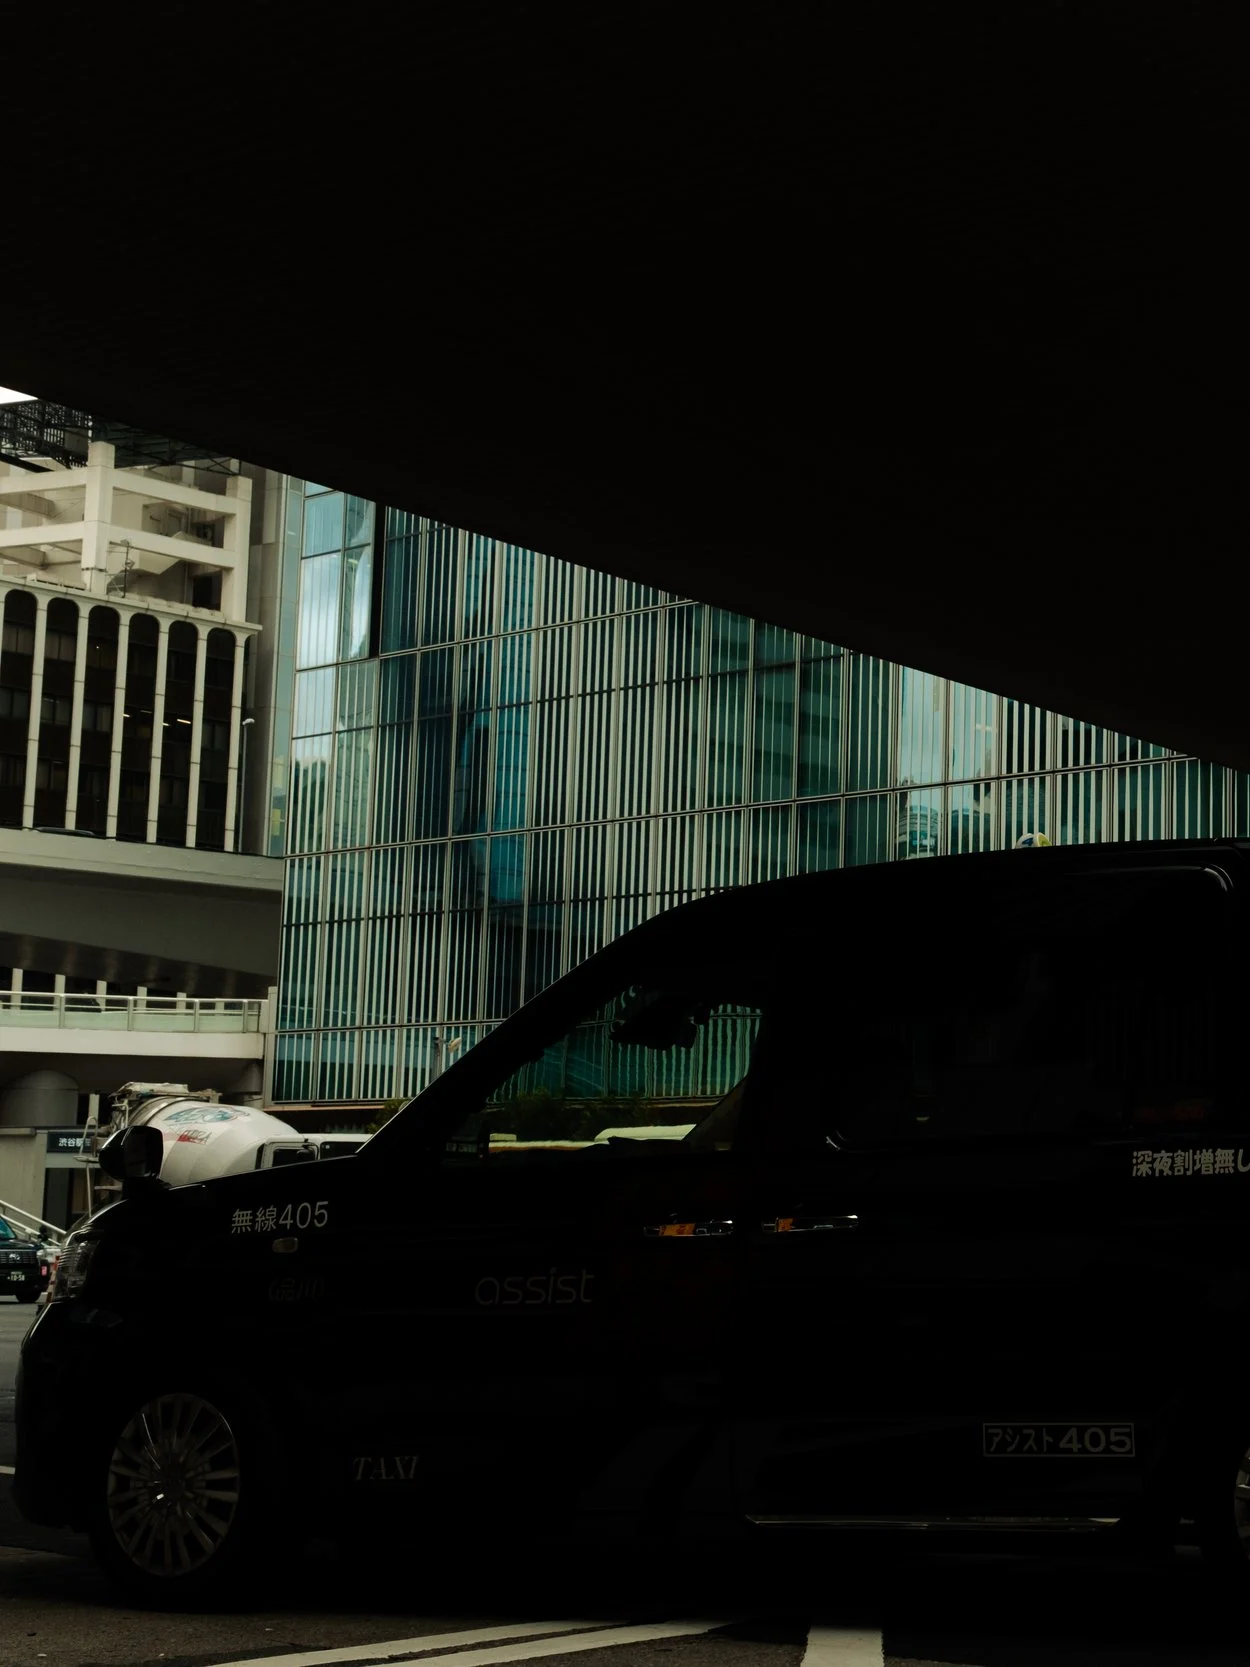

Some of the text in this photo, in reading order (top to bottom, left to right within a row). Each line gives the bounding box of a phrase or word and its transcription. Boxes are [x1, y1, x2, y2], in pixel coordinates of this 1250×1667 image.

[231, 1200, 329, 1234] 無線405
[474, 1266, 596, 1306] assist
[350, 1454, 421, 1481] TAXI
